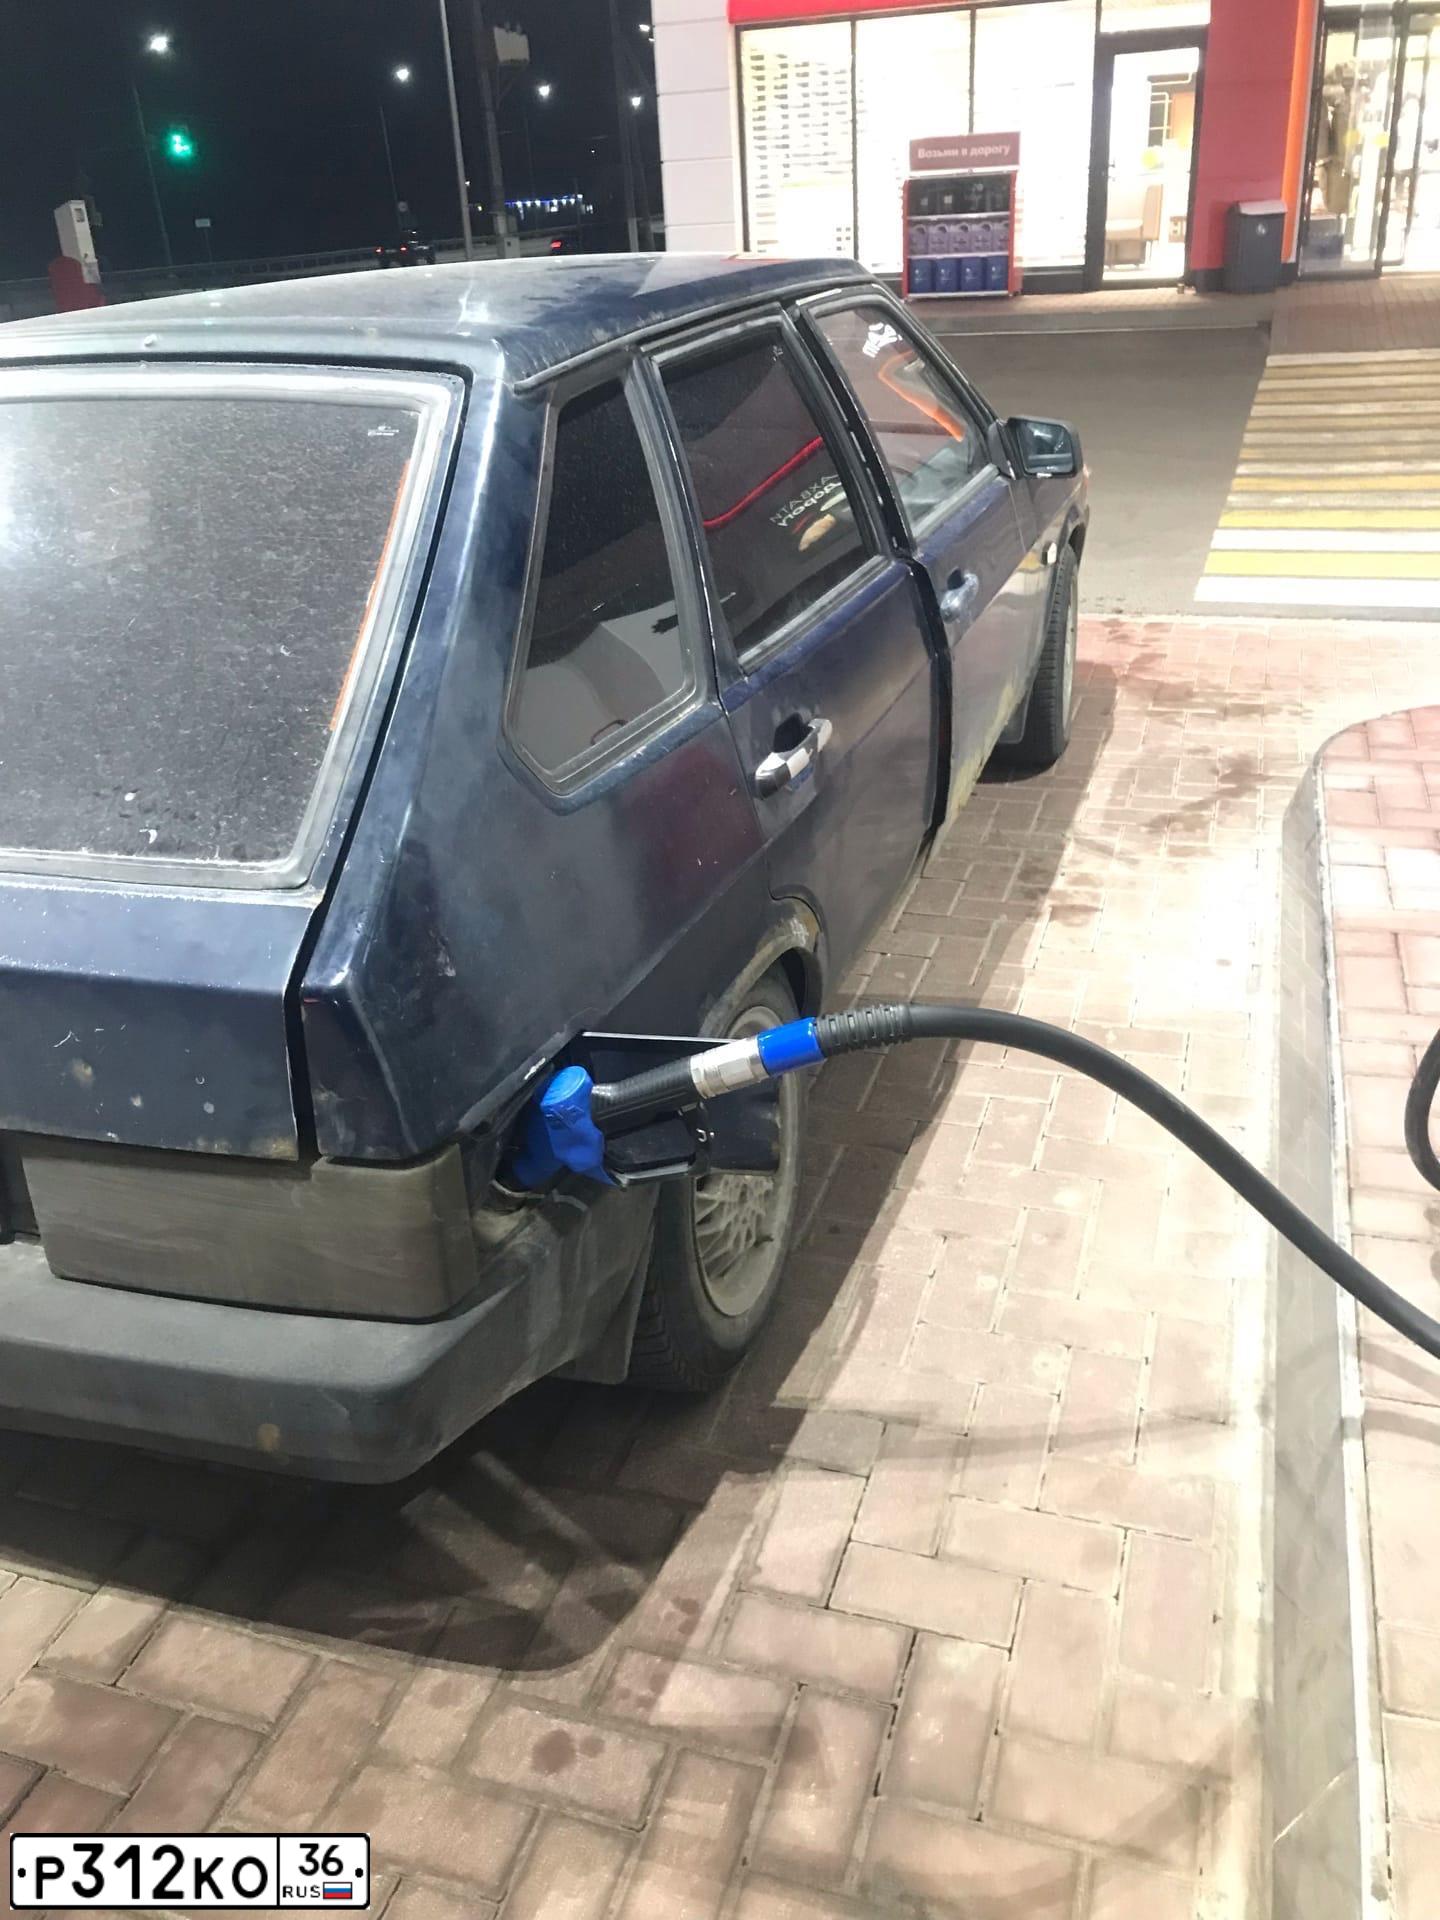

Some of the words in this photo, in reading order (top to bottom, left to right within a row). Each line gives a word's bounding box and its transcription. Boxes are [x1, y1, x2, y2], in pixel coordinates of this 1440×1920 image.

[917, 147, 959, 159] Возьми
[961, 148, 968, 156] в
[970, 144, 1010, 157] дорогу
